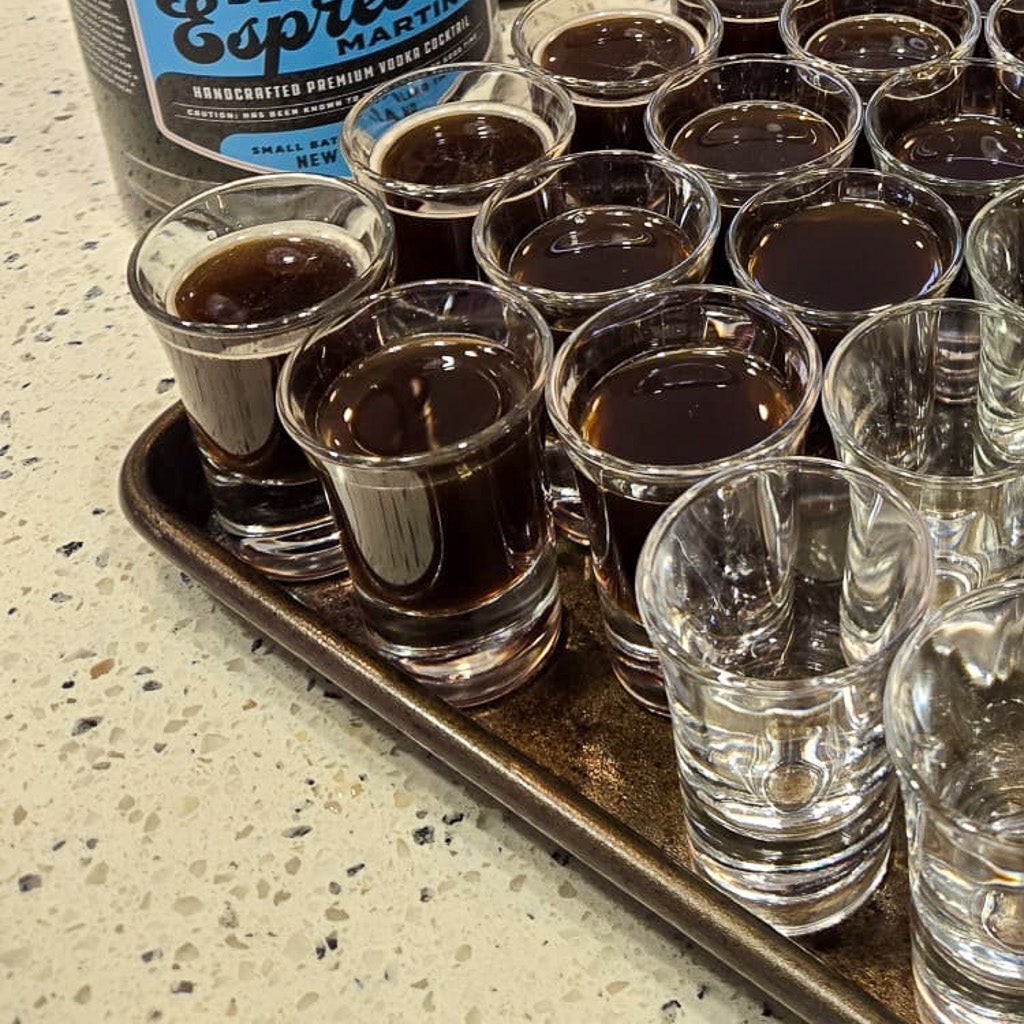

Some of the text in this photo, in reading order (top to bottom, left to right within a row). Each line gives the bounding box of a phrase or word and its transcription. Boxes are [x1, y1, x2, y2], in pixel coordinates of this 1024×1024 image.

[193, 84, 301, 101] HANDCRAFTED
[307, 66, 375, 93] PREMIUM
[378, 47, 421, 74] VODKA
[424, 15, 470, 54] COCKTAIL
[186, 108, 239, 120] CAUTION:
[242, 110, 265, 119] HAS
[269, 108, 299, 119] BEEN
[303, 100, 342, 114] KNOWN
[251, 137, 338, 155] SMALL BAT
[296, 149, 338, 169] NEW
